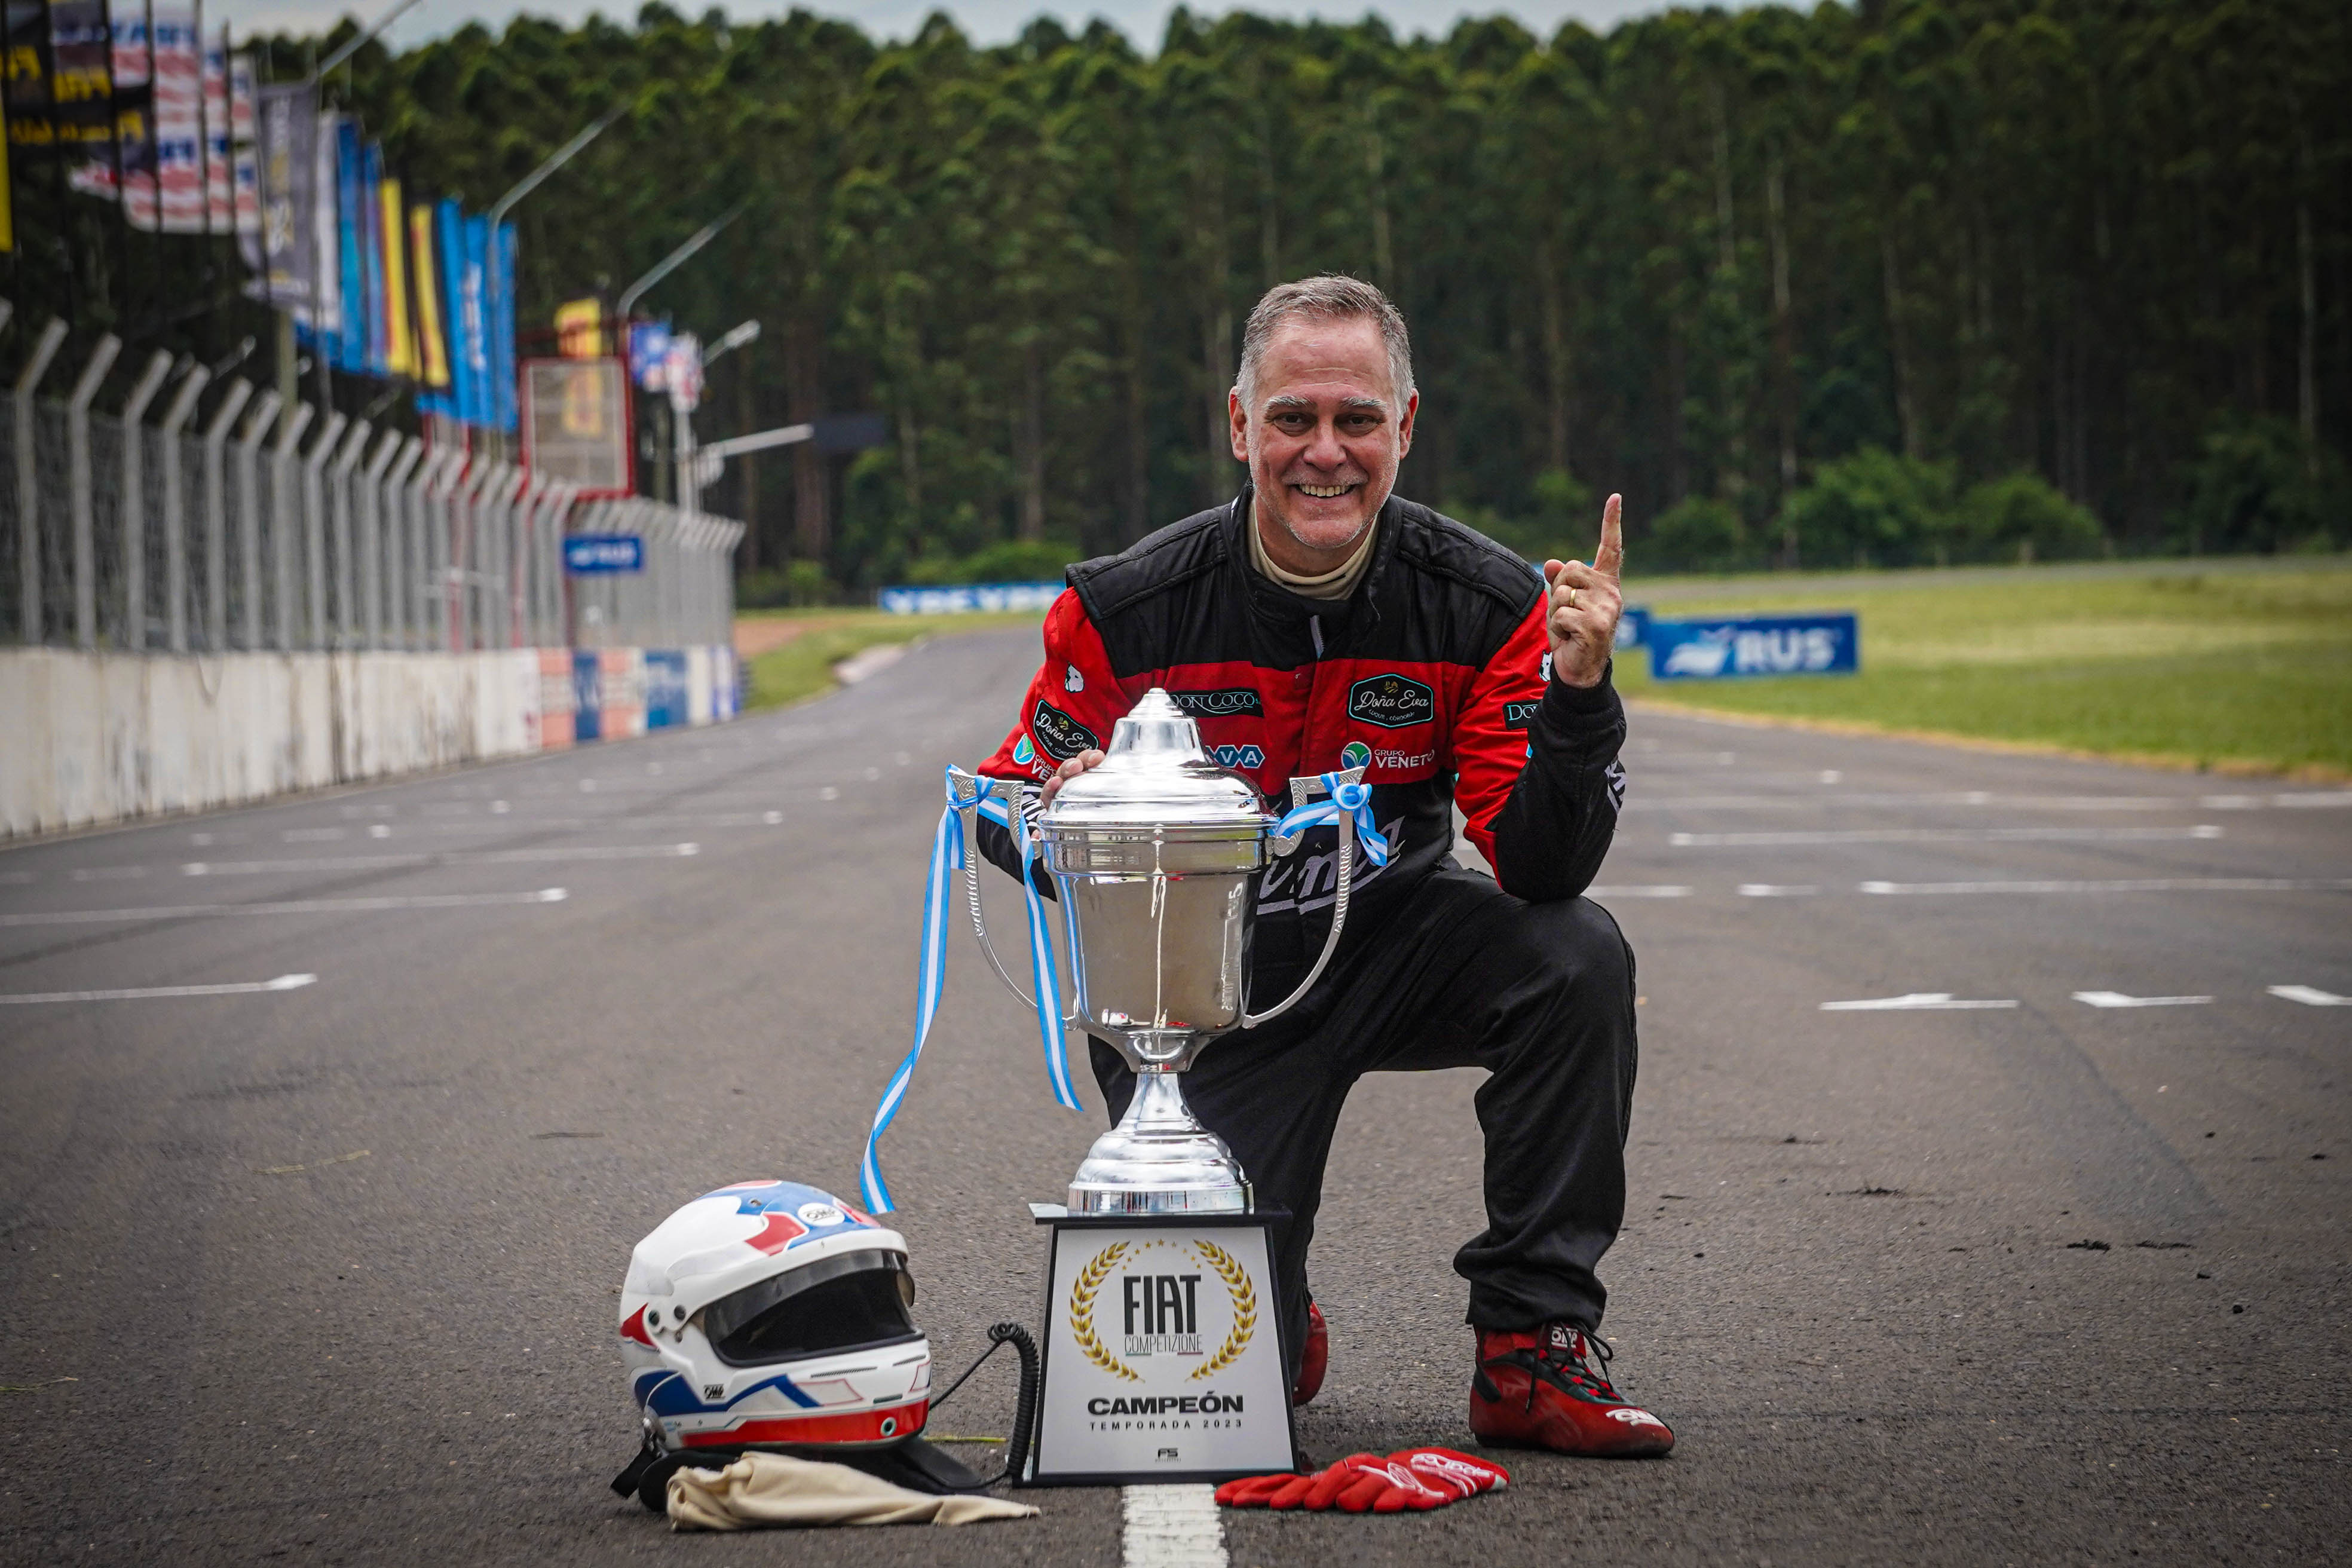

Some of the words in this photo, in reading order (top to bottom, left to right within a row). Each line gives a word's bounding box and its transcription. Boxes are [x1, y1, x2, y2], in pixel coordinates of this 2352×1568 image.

[1736, 627, 1835, 672] RUS
[1354, 691, 1395, 711] Doña
[1398, 690, 1429, 709] Eva
[1506, 704, 1538, 721] DO
[1036, 713, 1064, 741] Doña
[1376, 749, 1435, 768] VENETO
[1123, 1274, 1201, 1335] FIAT
[1125, 1334, 1202, 1353] COMPETIZIONE
[1088, 1390, 1244, 1416] CAMPEÓN
[1090, 1420, 1191, 1431] TEMPORADA
[1203, 1419, 1242, 1429] 2023
